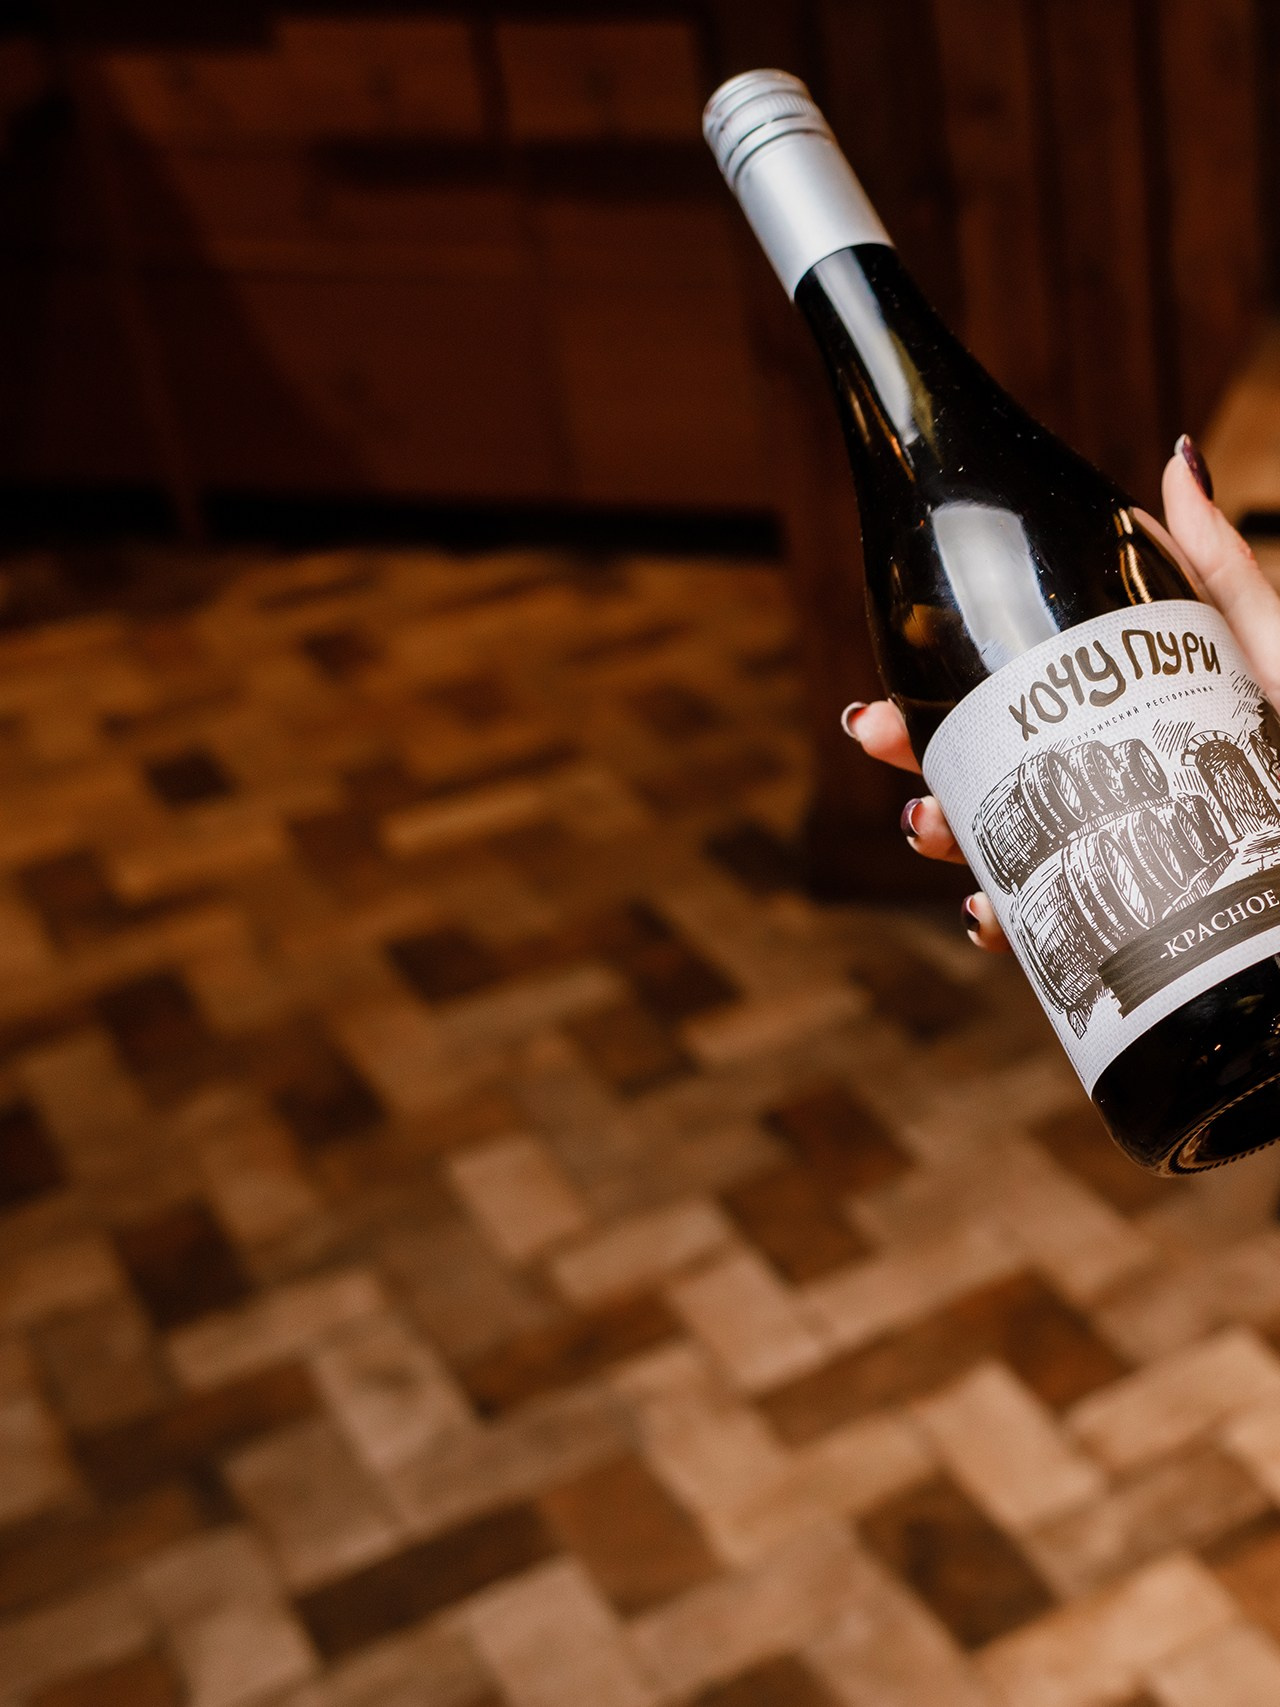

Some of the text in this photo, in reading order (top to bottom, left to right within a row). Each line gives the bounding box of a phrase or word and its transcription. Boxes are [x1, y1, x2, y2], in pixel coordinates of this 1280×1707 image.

[1008, 629, 1221, 741] ХОЧУ ПУРИ
[1070, 685, 1214, 746] ГРУЗИНСКИЙ РЕСТОРАНЧИК
